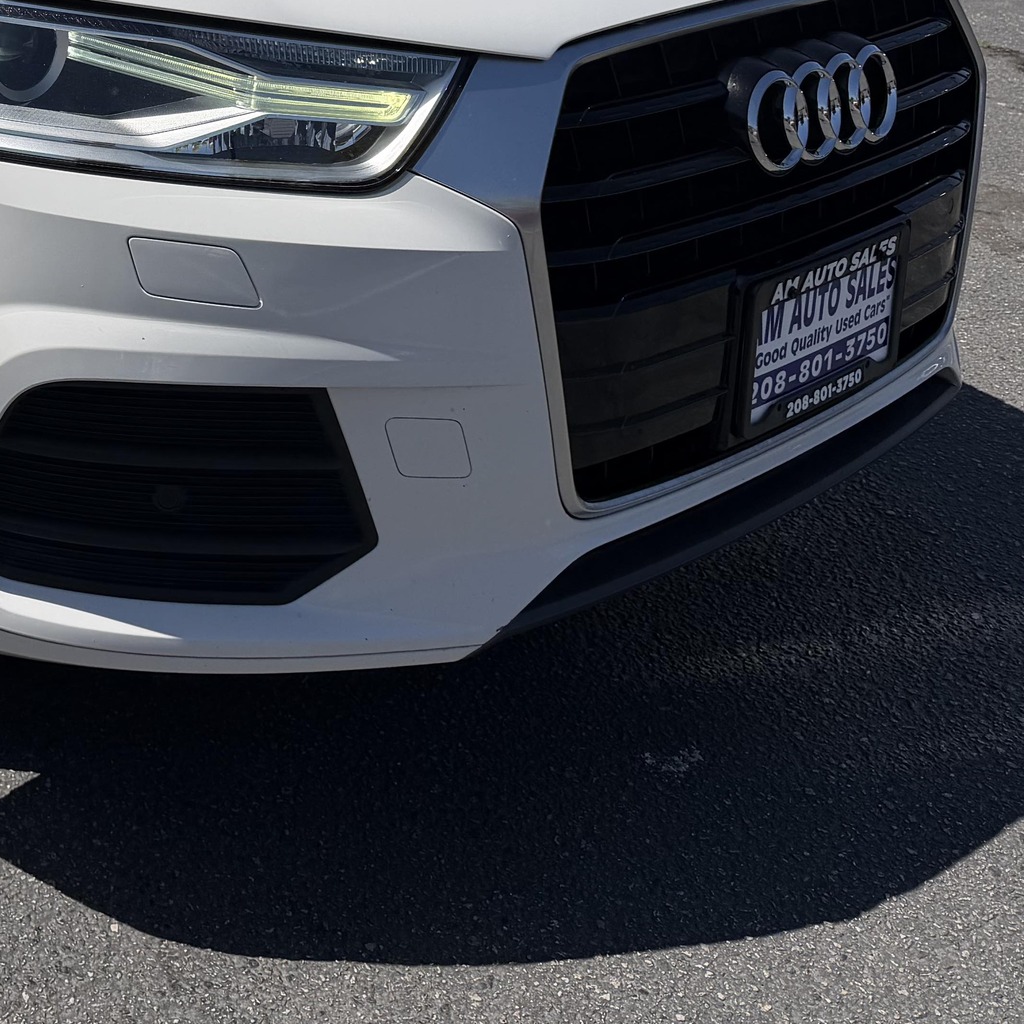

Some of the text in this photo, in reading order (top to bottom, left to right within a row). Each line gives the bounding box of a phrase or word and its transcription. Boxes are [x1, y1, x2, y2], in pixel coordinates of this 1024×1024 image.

[788, 280, 841, 335] AUTO
[846, 258, 897, 309] SALES
[801, 257, 848, 292] AUTO
[751, 321, 888, 405] 208-801-3750
[755, 341, 787, 369] Good
[791, 323, 833, 356] Quality
[835, 311, 861, 335] Used
[786, 367, 862, 418] 208-801-3750
